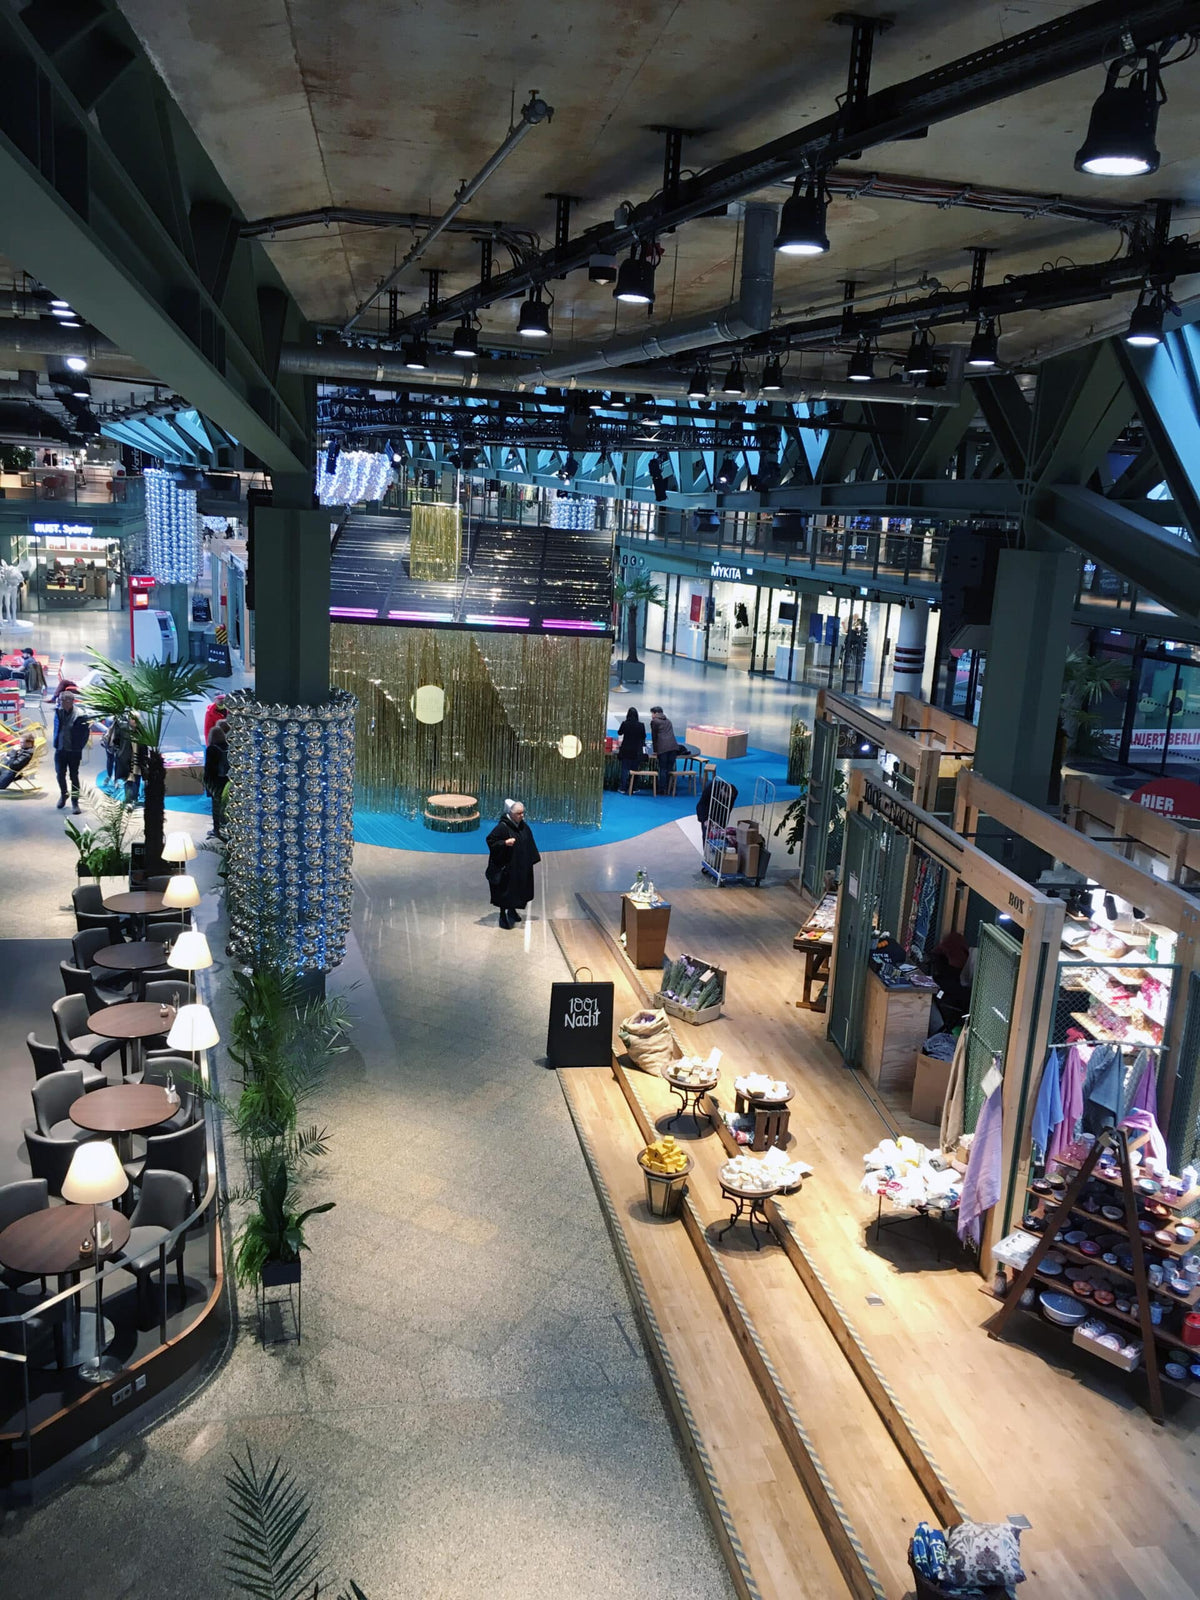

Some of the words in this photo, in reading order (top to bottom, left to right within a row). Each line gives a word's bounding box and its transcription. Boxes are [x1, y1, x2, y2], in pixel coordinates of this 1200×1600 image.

[62, 524, 93, 535] Sydney
[711, 565, 741, 579] MYKITA
[1140, 793, 1174, 811] HIER
[1008, 891, 1024, 914] BOX
[569, 997, 598, 1013] 1001
[565, 1009, 601, 1029] Nacht
